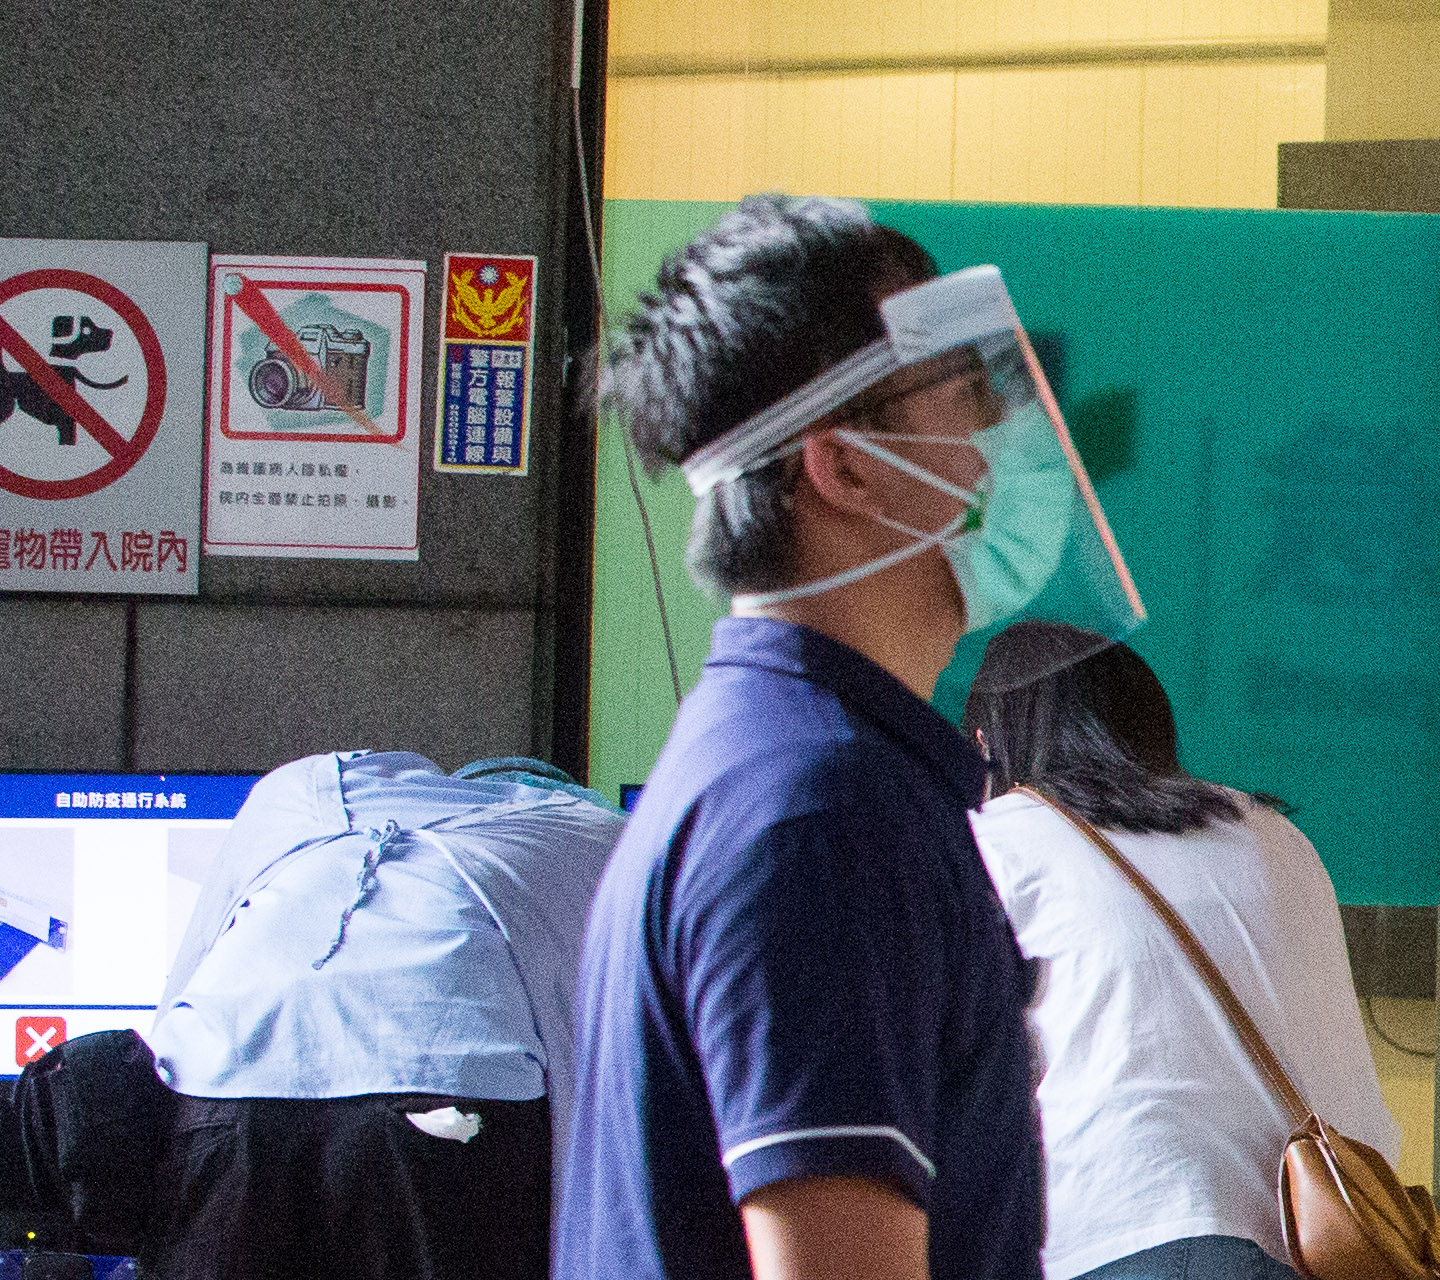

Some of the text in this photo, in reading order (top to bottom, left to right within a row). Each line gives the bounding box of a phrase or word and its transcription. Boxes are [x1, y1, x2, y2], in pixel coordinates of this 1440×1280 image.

[0, 527, 189, 574] 物帶入院內
[55, 790, 188, 810] 自助防疫通行系統
